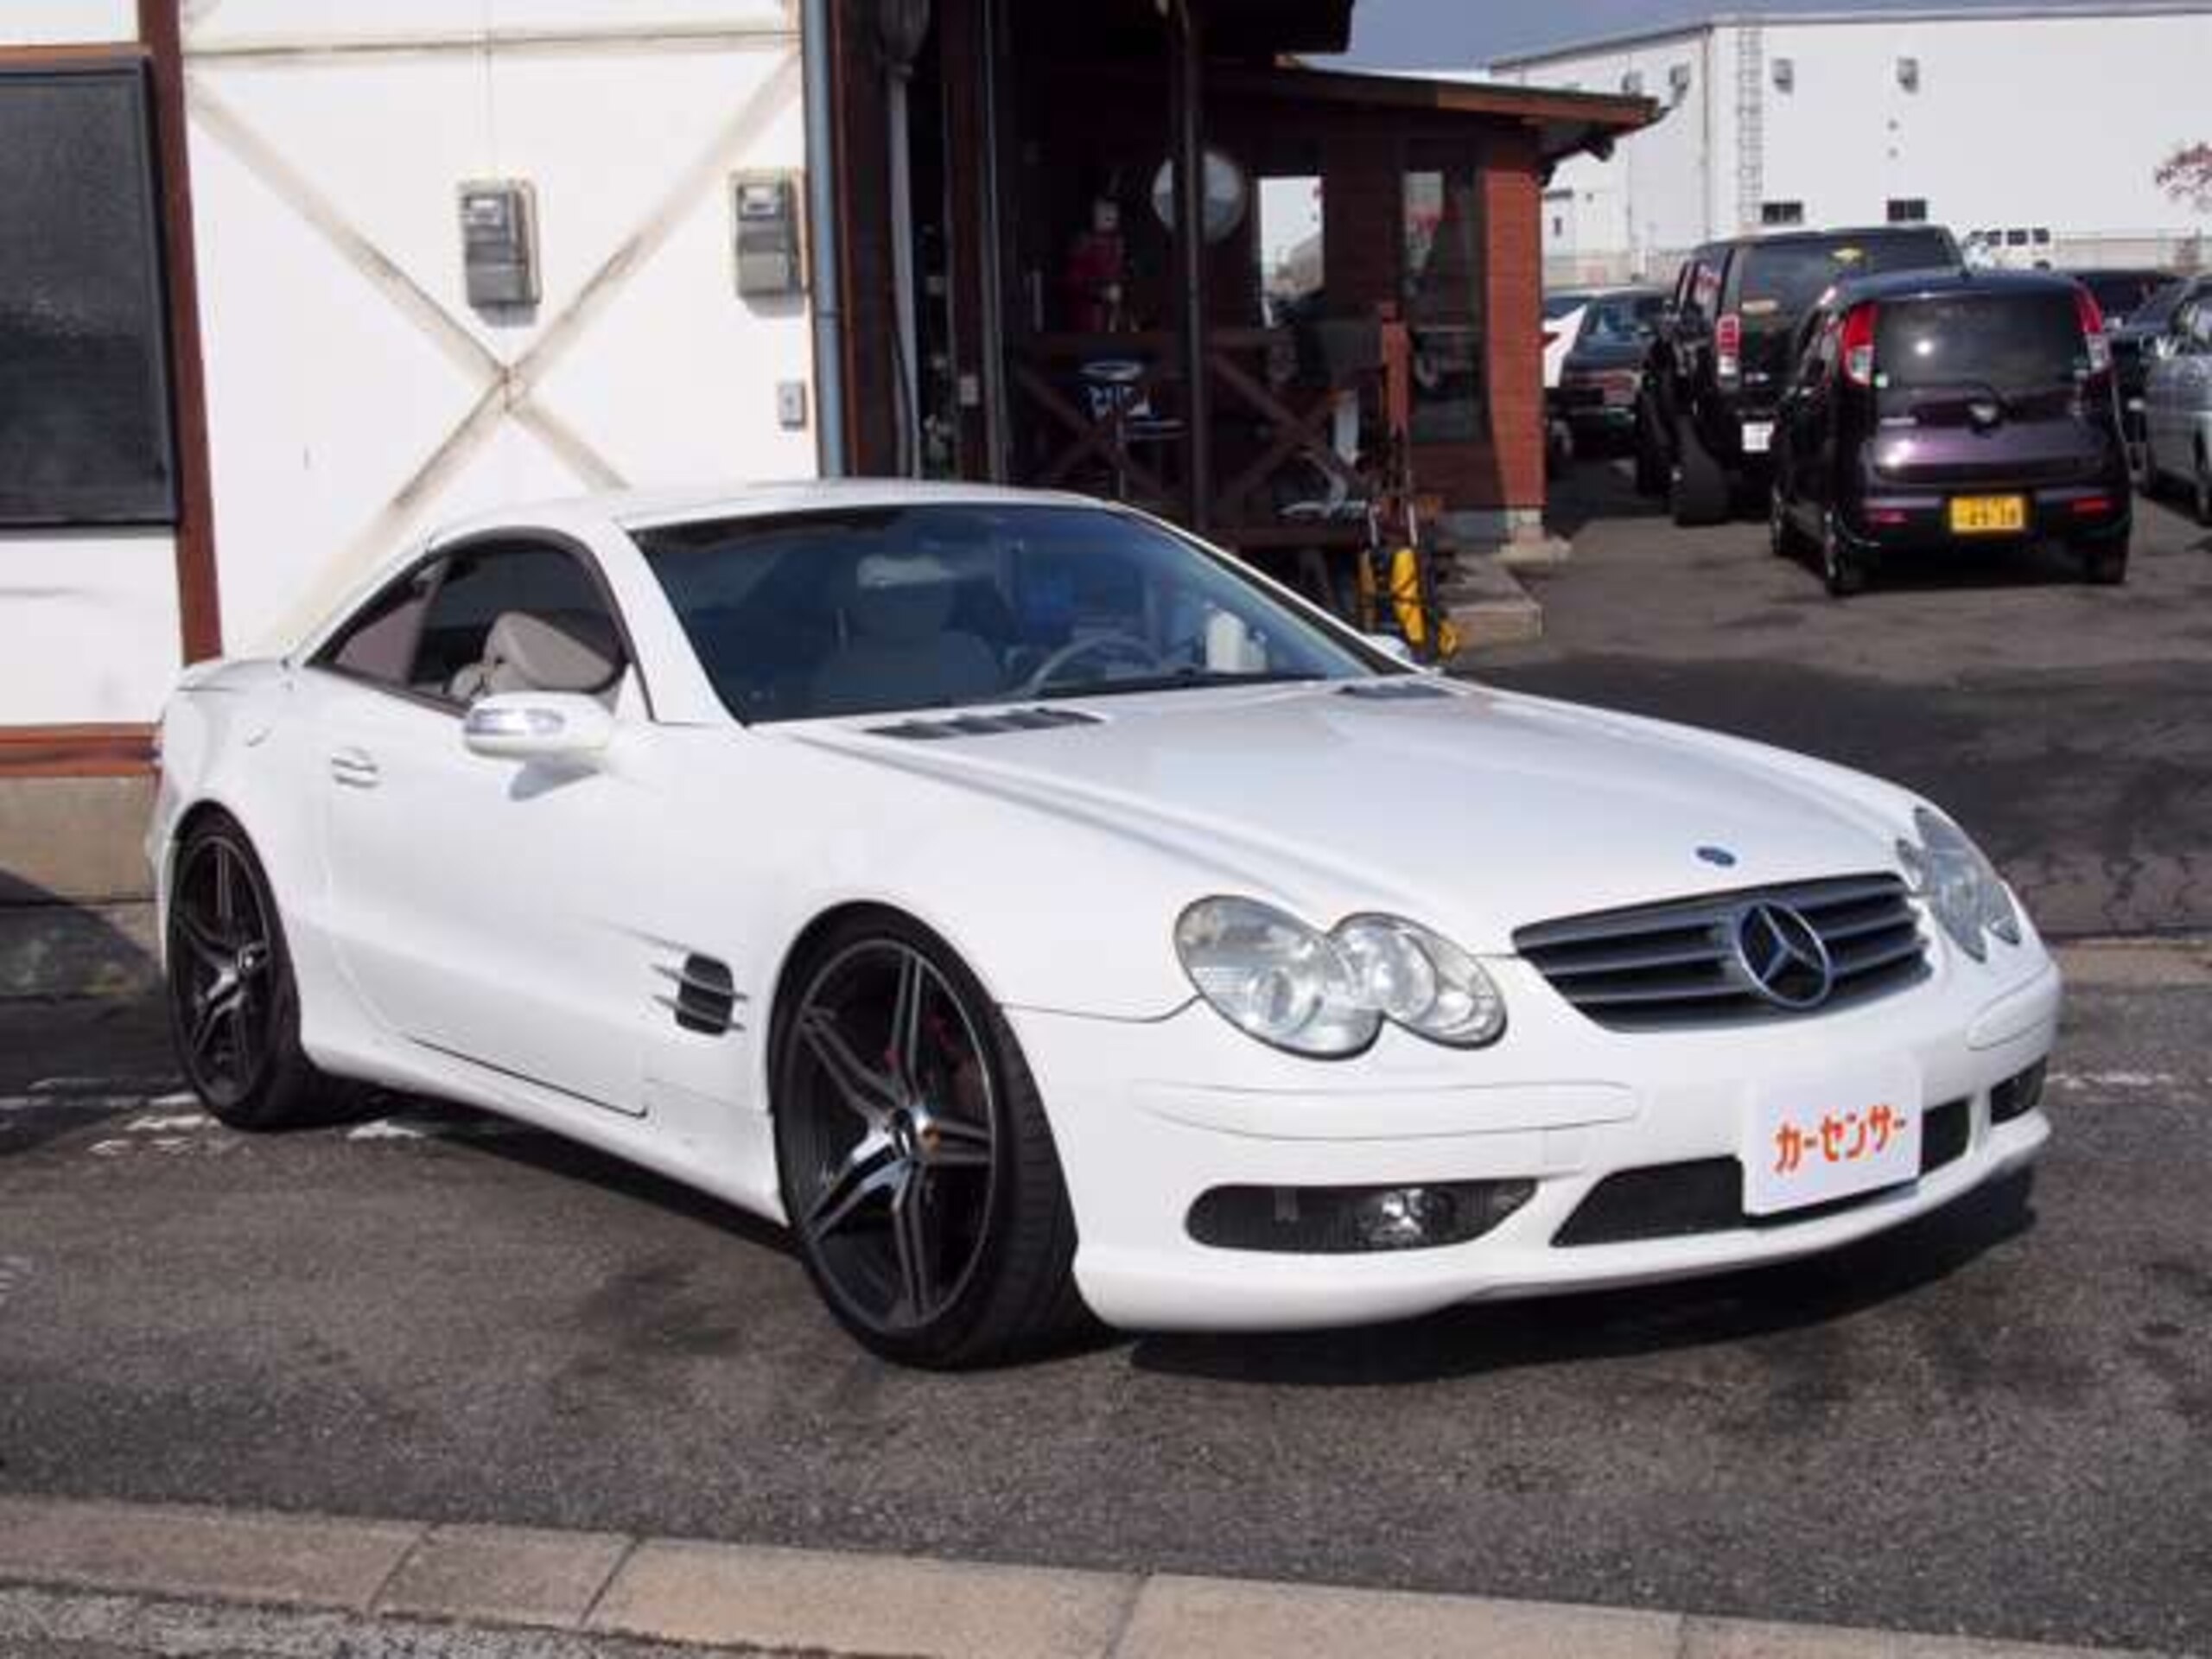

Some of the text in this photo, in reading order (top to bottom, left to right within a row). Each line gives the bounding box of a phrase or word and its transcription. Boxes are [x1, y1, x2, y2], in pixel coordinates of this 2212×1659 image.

[1775, 1104, 1906, 1173] カーセンサー
